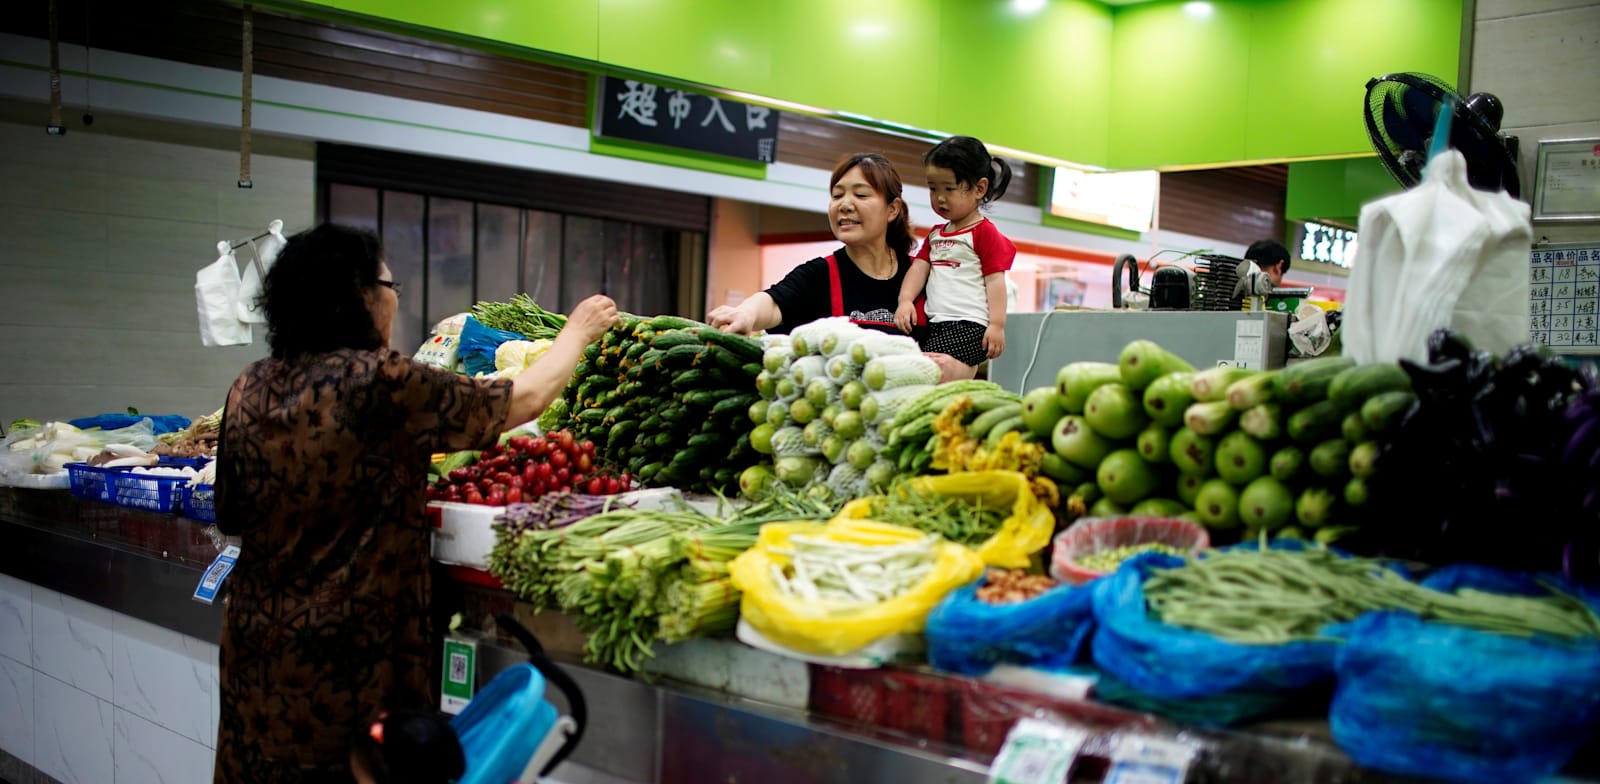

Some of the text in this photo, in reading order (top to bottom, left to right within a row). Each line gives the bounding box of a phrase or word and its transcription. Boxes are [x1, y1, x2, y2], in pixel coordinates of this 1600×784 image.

[617, 80, 771, 133] 超市入口
[1531, 252, 1552, 264] 品名
[1578, 250, 1600, 261] 品名
